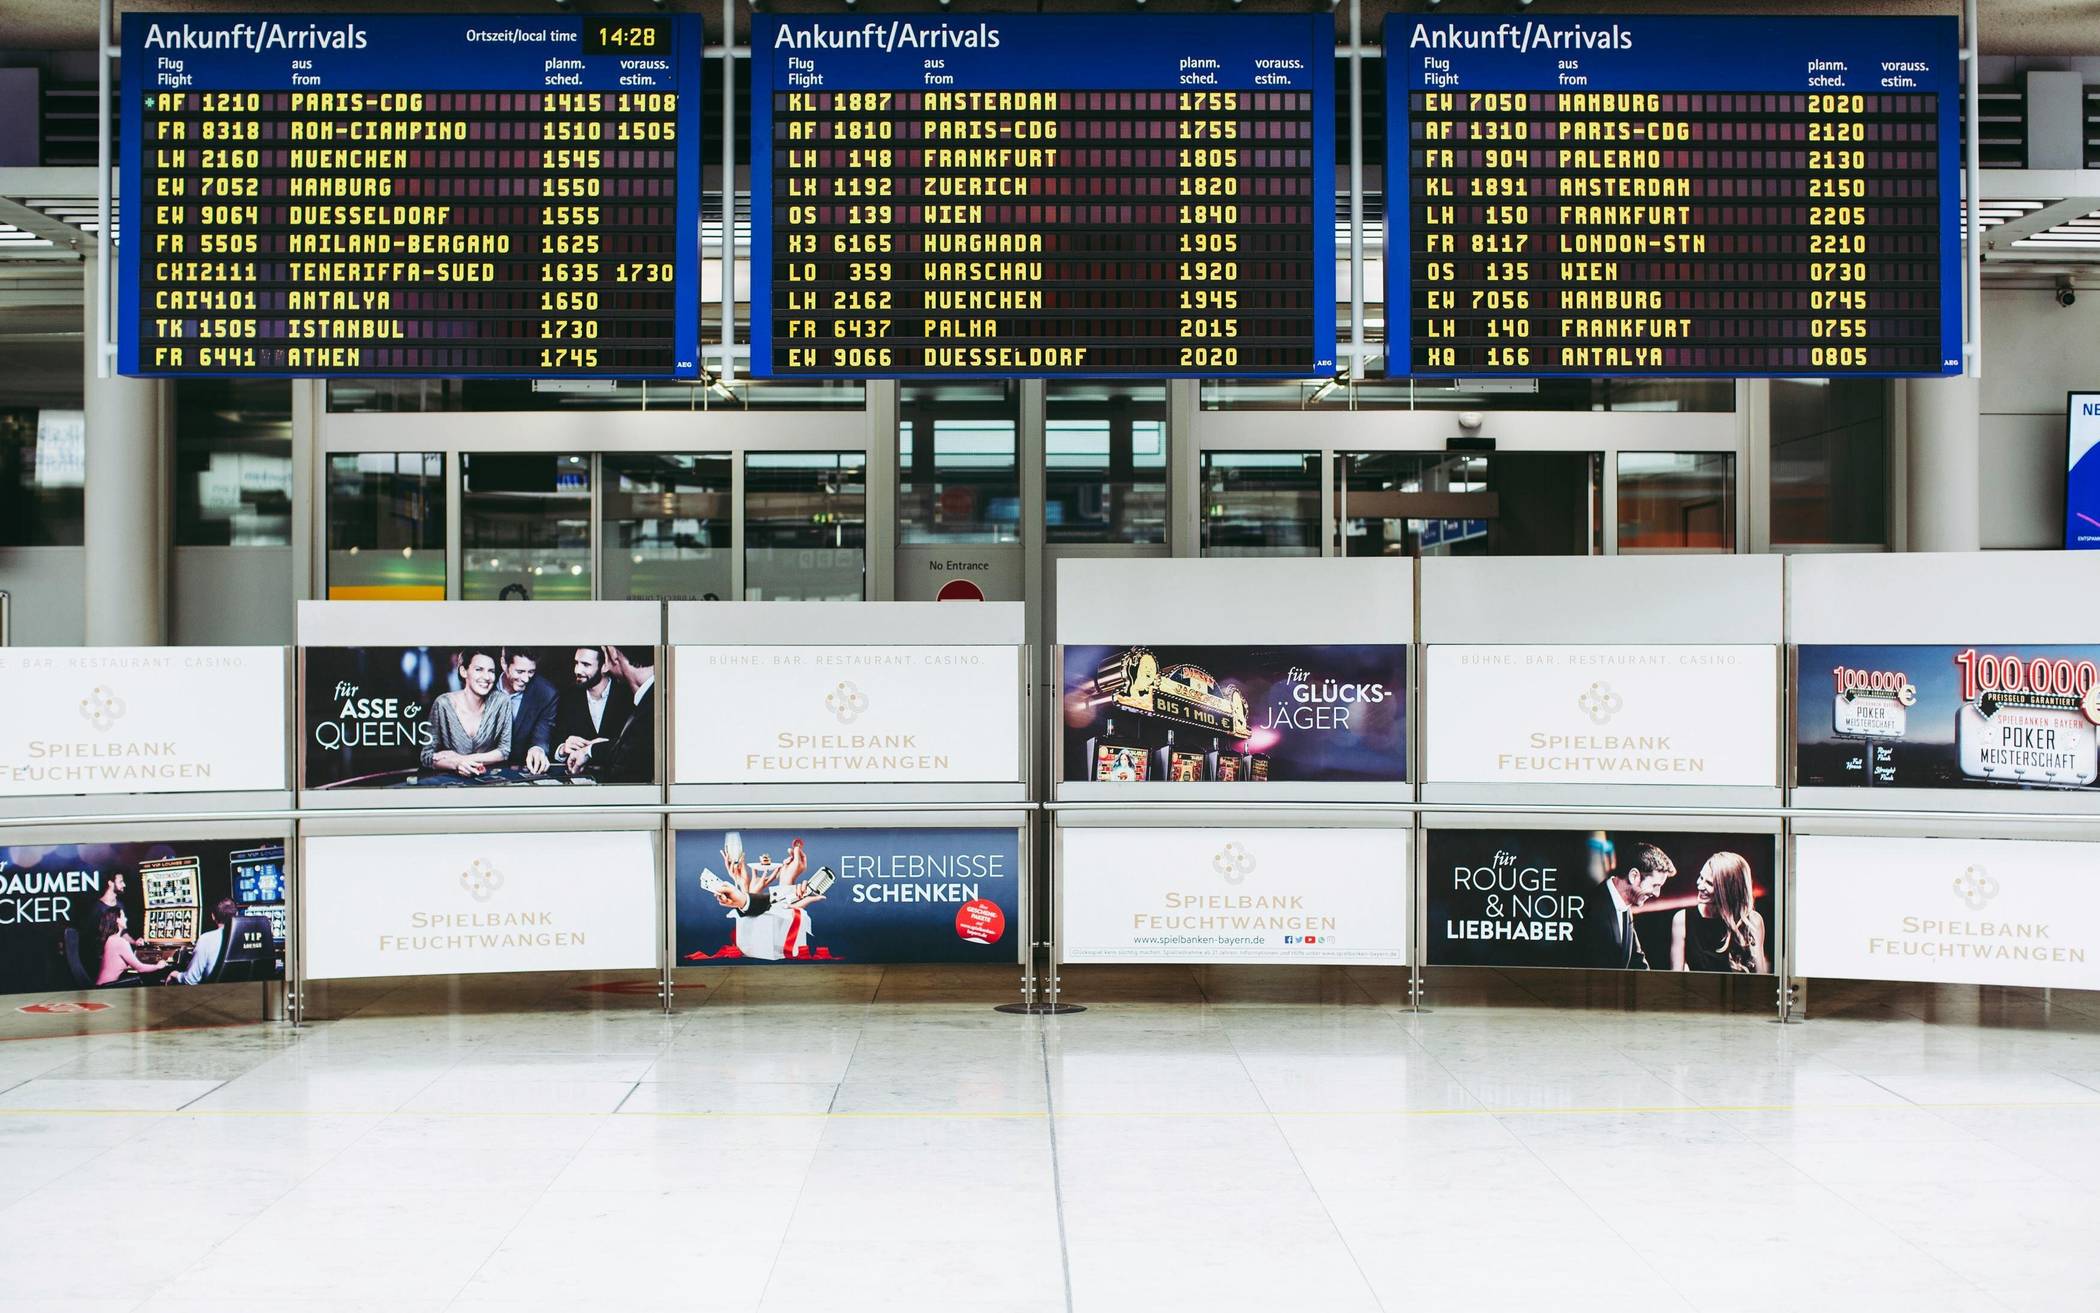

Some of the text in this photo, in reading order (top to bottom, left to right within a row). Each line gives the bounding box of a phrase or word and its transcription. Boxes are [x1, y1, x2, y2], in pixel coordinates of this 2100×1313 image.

[144, 21, 368, 54] Ankunft/Arrivals
[466, 28, 578, 44] Ortszeit/local time
[599, 28, 656, 46] 14:28
[774, 20, 1000, 53] Ankunft/Arrivals
[1409, 21, 1633, 53] Ankunft/Arrivals
[159, 57, 670, 72] Flug aus planm. vorauss.
[789, 56, 1304, 72] Flug aus planm. vorauss.
[1425, 56, 1930, 71] Flug aus planm. vorauss.
[158, 71, 664, 88] Flight from sched. estim.
[789, 71, 1291, 87] Flight from sched. estim.
[1425, 71, 1917, 87] Flight from sched. estim.
[158, 93, 676, 112] AF 1210 PARIS-CDG 1415 1408
[789, 92, 1237, 112] KL 1887 AMSTERDAM 1755
[1425, 93, 1864, 113] EW 7050 HAMBURG 2020
[158, 121, 675, 140] FR 8318 ROM-CIAMPINO 1510 1505
[157, 177, 600, 197] EW 7052 HAMBURG 1550
[789, 177, 1237, 196] LX 1192 ZUERICH 1820
[1426, 177, 1865, 197] KL 1891 AMSTERDAM 2150
[156, 234, 599, 254] FR 5505 MAILAND-BERGAMO 1625
[789, 234, 1237, 253] X3 6165 HURGHADA 1905
[1427, 234, 1866, 253] FR 8117 LONDON-STN 2210
[156, 262, 673, 282] CXI2111 TENERIFFA-SUED 1635 1730
[1428, 290, 1866, 310] EW 7056 HAMBURG 0745
[155, 319, 598, 339] TK 1505 ISTANBUL 1730
[789, 319, 1237, 338] FR 6437 PALMA 2015
[1428, 347, 1867, 366] XQ 166 ANTALYA 0805
[929, 561, 990, 571] No Entrance
[924, 655, 986, 665] CASINO.
[1286, 666, 1311, 686] für
[1956, 649, 2097, 701] 100.000
[333, 680, 360, 701] für
[1292, 679, 1393, 703] GLÜCKS-
[1987, 693, 2076, 707] PREISGELD GARANTIERT
[339, 698, 399, 719] ASSE
[1156, 698, 1180, 715] BIS
[1183, 706, 1191, 718] 1
[1260, 701, 1351, 730] JÄGER
[1856, 706, 1886, 720] POKER
[1997, 714, 2085, 730] SPIELBANKEN BAYERN
[315, 720, 434, 750] QUEENS
[776, 731, 918, 749] SPIELBANK
[1529, 732, 1672, 750] SPIELBANK
[2002, 726, 2057, 750] POKER
[28, 740, 177, 759] SPIELBANK
[1980, 748, 2077, 770] MEISTERSCHAFT
[745, 754, 951, 771] FEUCHTWANGEN
[1498, 753, 1705, 772] FEUCHTWANGEN
[840, 854, 1005, 880] ERLEBNISSE
[1493, 850, 1518, 869] für
[1454, 866, 1558, 893] ROUGE
[852, 883, 979, 903] SCHENKEN
[1164, 891, 1305, 910] SPIELBANK
[1485, 893, 1586, 920] & NOIR
[411, 910, 553, 929] SPIELBANK
[1133, 913, 1337, 931] FEUCHTWANGEN
[1901, 916, 2050, 939] SPIELBANK
[243, 932, 263, 942] VIP
[1446, 919, 1575, 942] LIEBHABER
[378, 931, 587, 952] FEUCHTWANGEN
[1133, 934, 1266, 947] www.spielbanken-bayern.de
[1867, 937, 2086, 964] FEUCHTWANGEN
